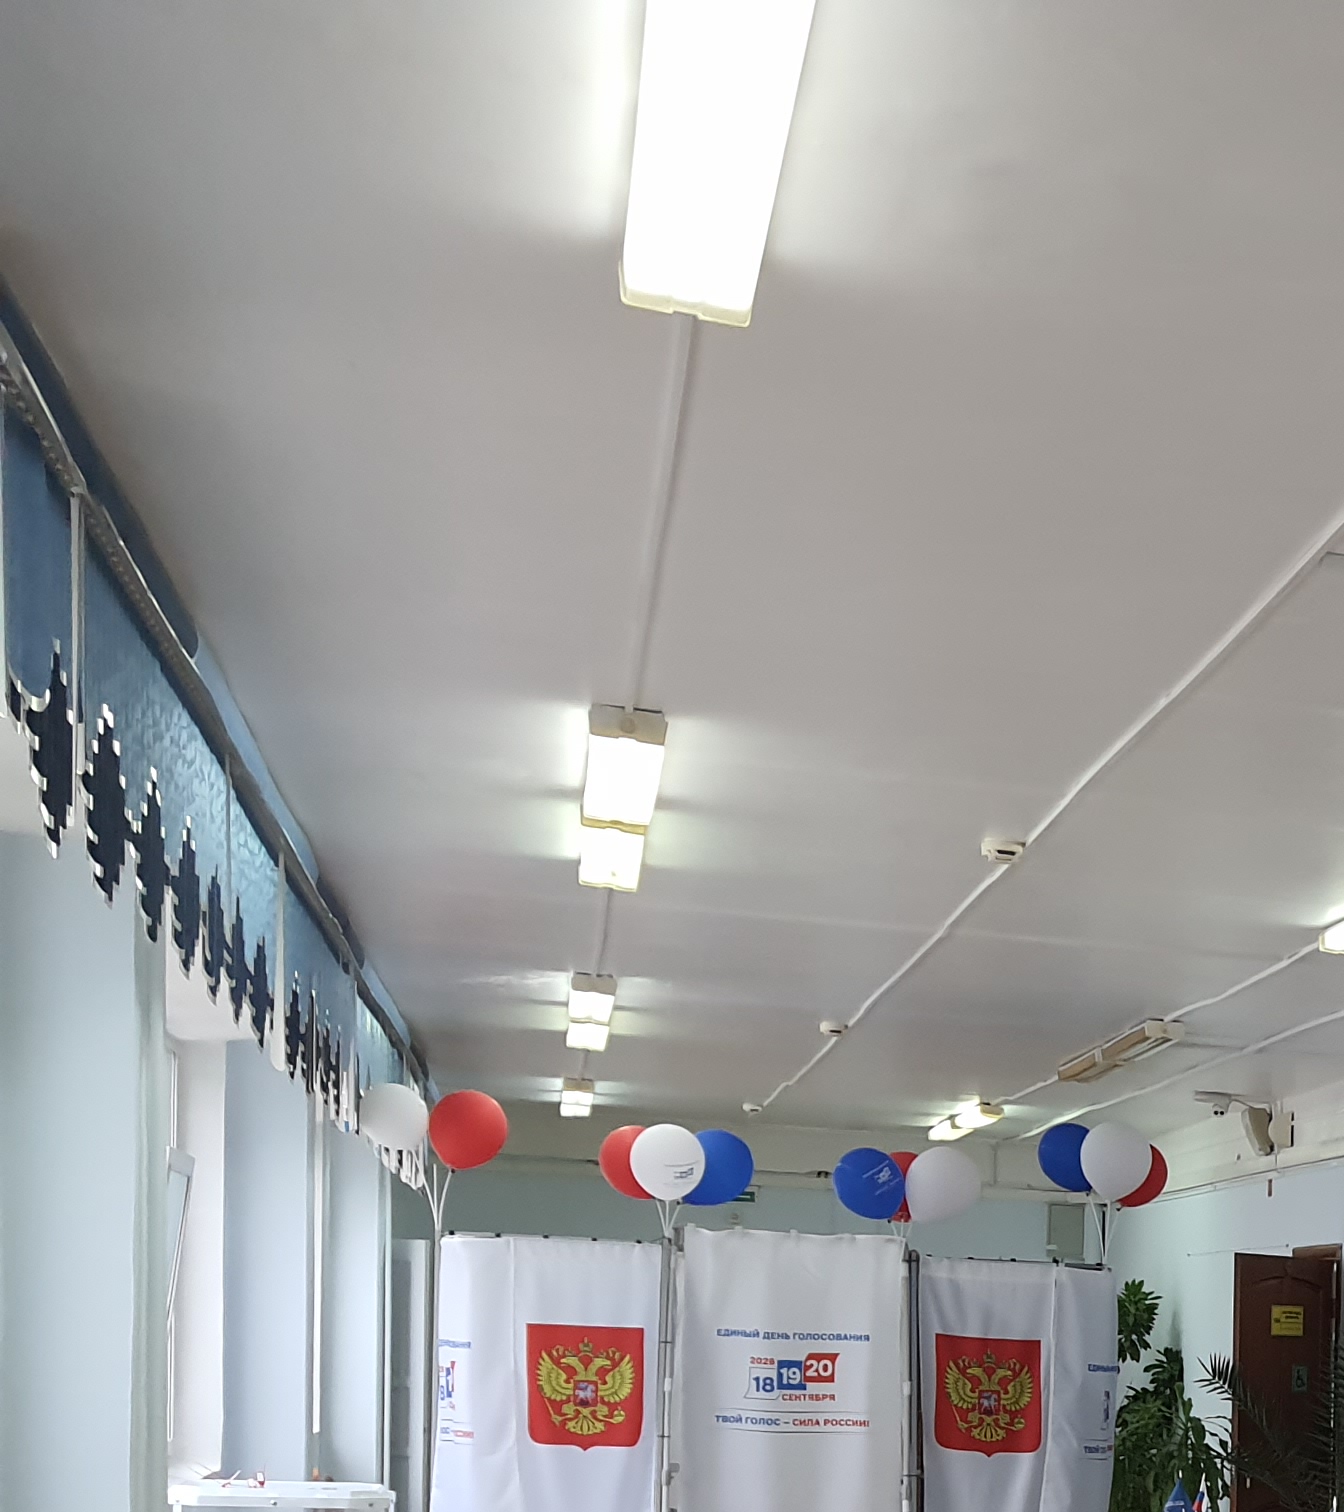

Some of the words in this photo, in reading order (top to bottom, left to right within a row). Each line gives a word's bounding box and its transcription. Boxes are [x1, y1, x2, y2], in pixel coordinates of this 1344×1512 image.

[716, 1328, 760, 1339] ЕДИНЫЙ
[762, 1331, 791, 1341] ДЕНЬ
[793, 1333, 870, 1342] ГОЛОСОВАНИЯ
[752, 1376, 775, 1393] 18
[779, 1367, 801, 1385] 19
[805, 1359, 833, 1377] 20
[781, 1393, 836, 1402] СЕНТЯБРЯ
[715, 1414, 743, 1424] ТВОЙ
[745, 1416, 781, 1426] ГОЛОС
[792, 1418, 820, 1427] СИЛА
